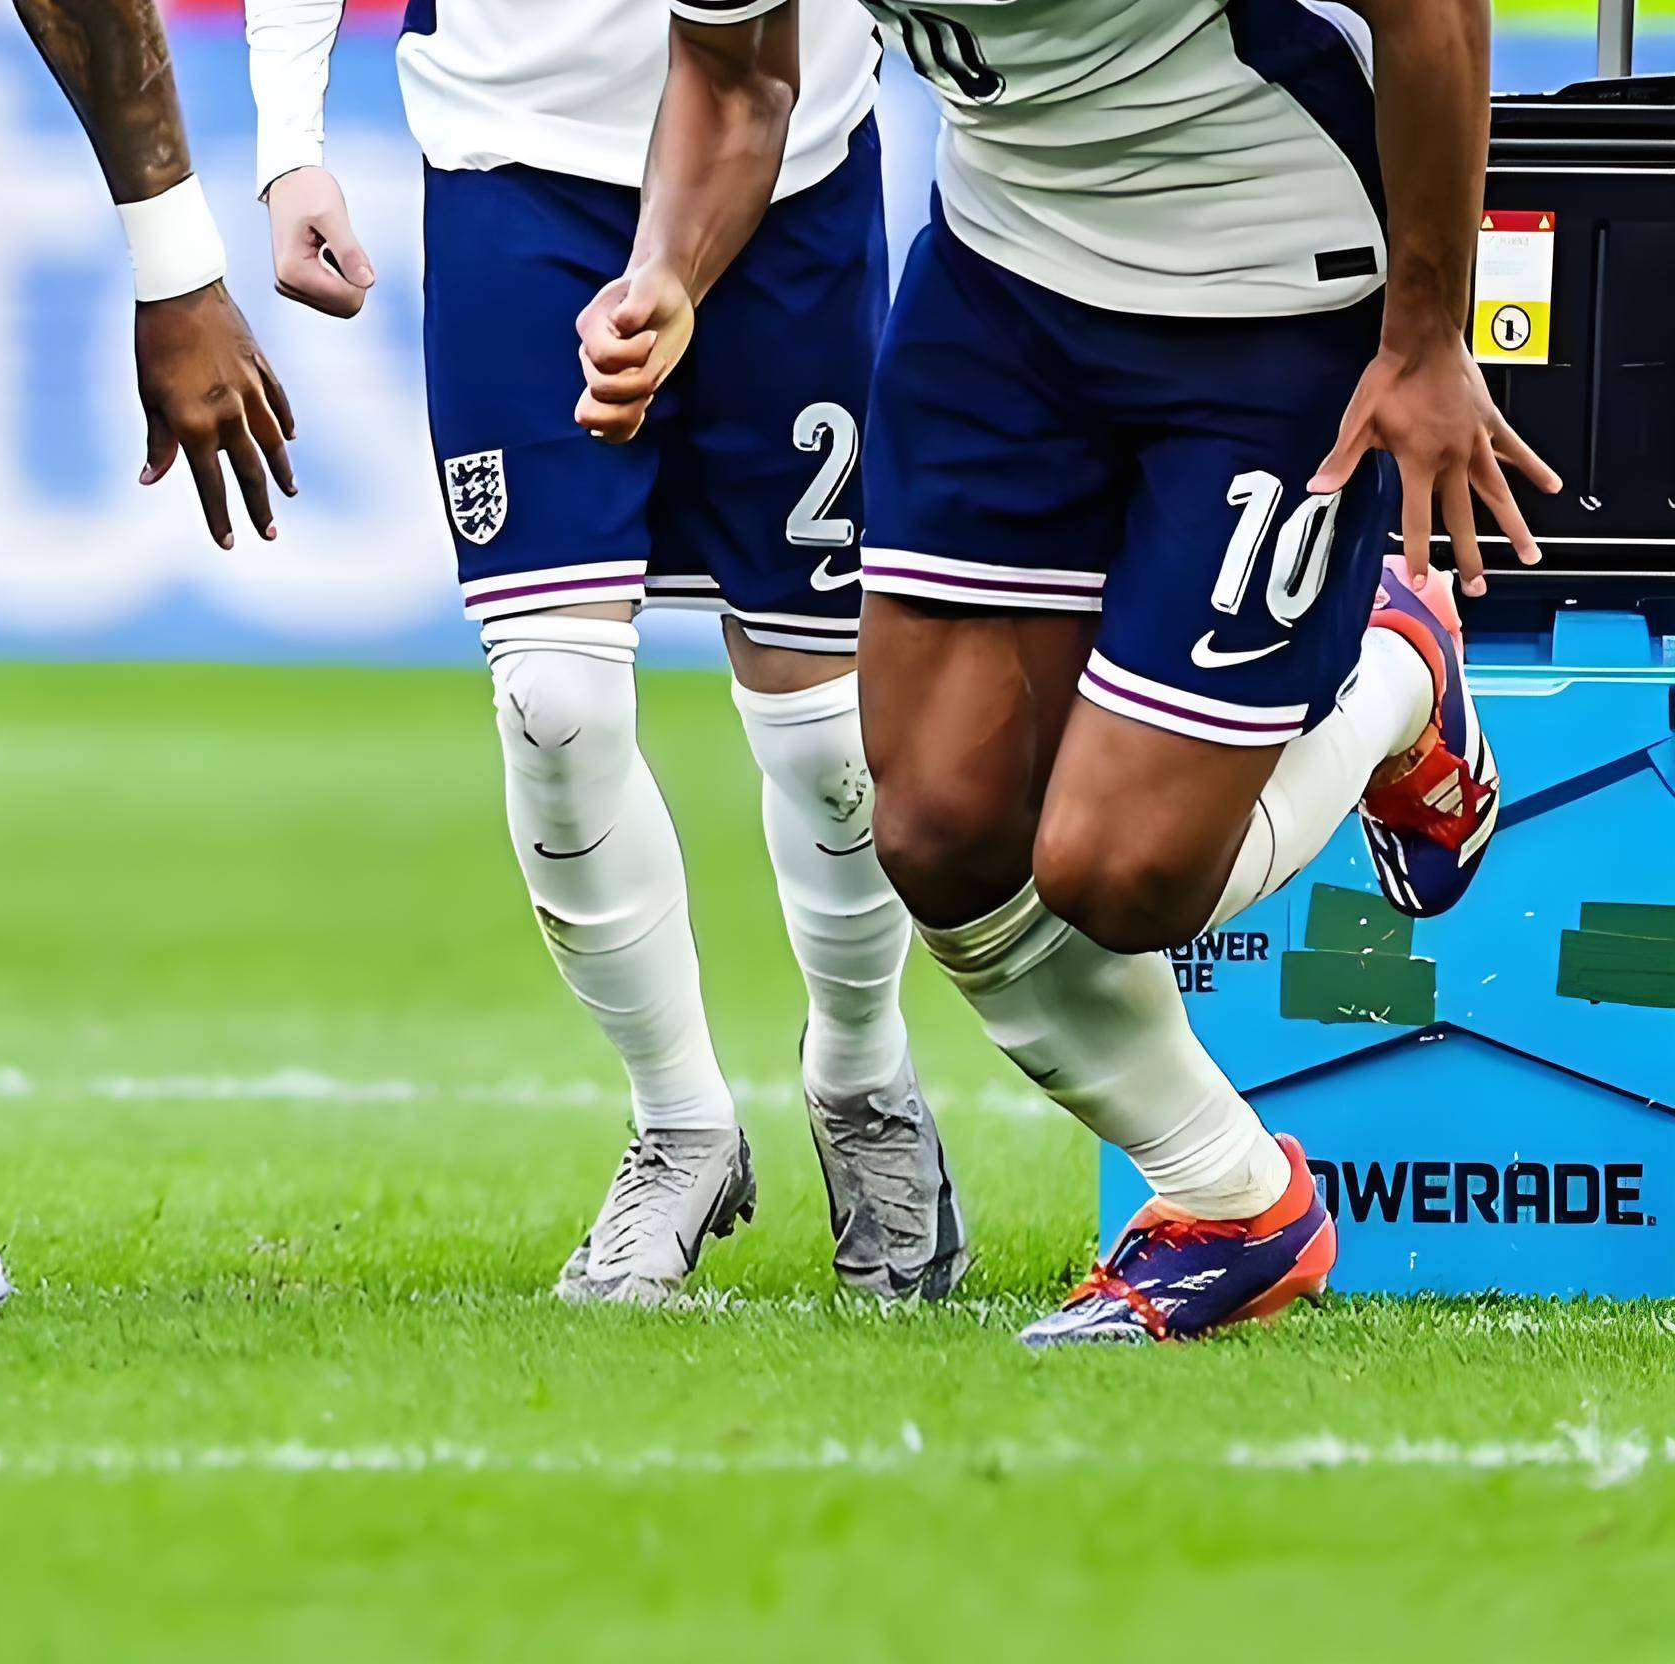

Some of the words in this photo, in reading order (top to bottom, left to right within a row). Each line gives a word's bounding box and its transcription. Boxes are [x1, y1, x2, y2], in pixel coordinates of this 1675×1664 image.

[785, 401, 860, 547] 2
[1210, 470, 1343, 628] 10
[1163, 931, 1270, 961] OWER
